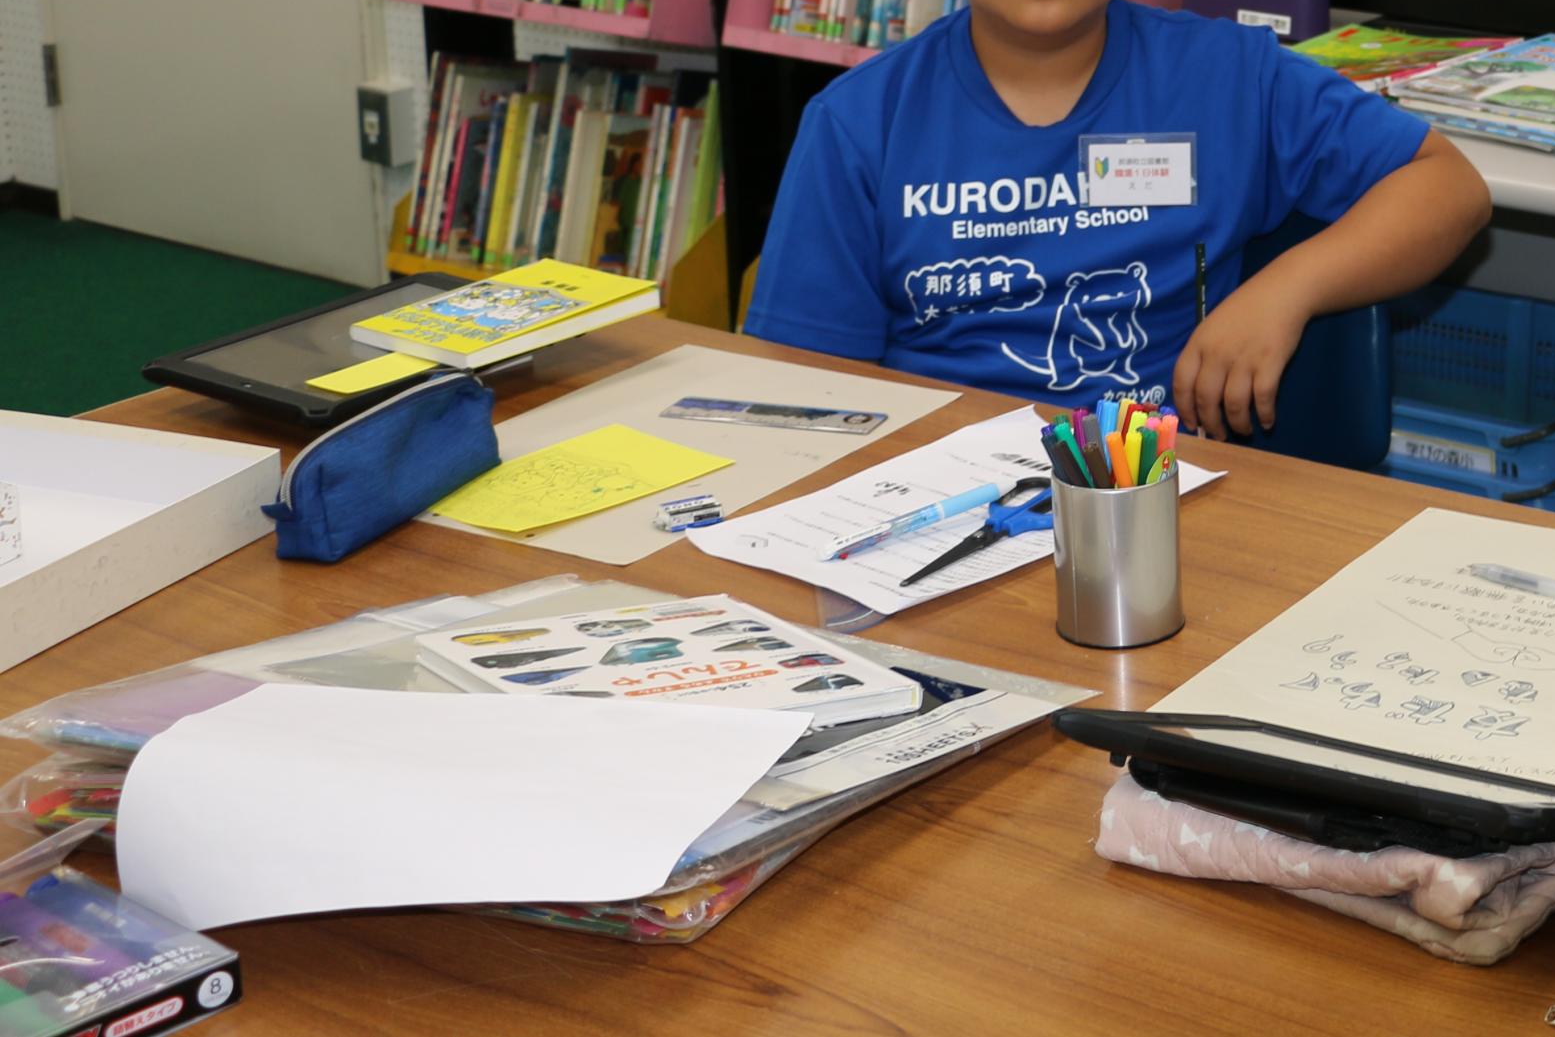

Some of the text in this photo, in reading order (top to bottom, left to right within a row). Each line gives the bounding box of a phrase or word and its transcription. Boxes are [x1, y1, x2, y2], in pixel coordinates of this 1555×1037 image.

[903, 171, 1090, 218] KURODA
[952, 206, 1149, 240] Elementary School
[924, 271, 1015, 297] 那須町
[611, 659, 763, 687] でんしゃ
[210, 978, 222, 995] 8
